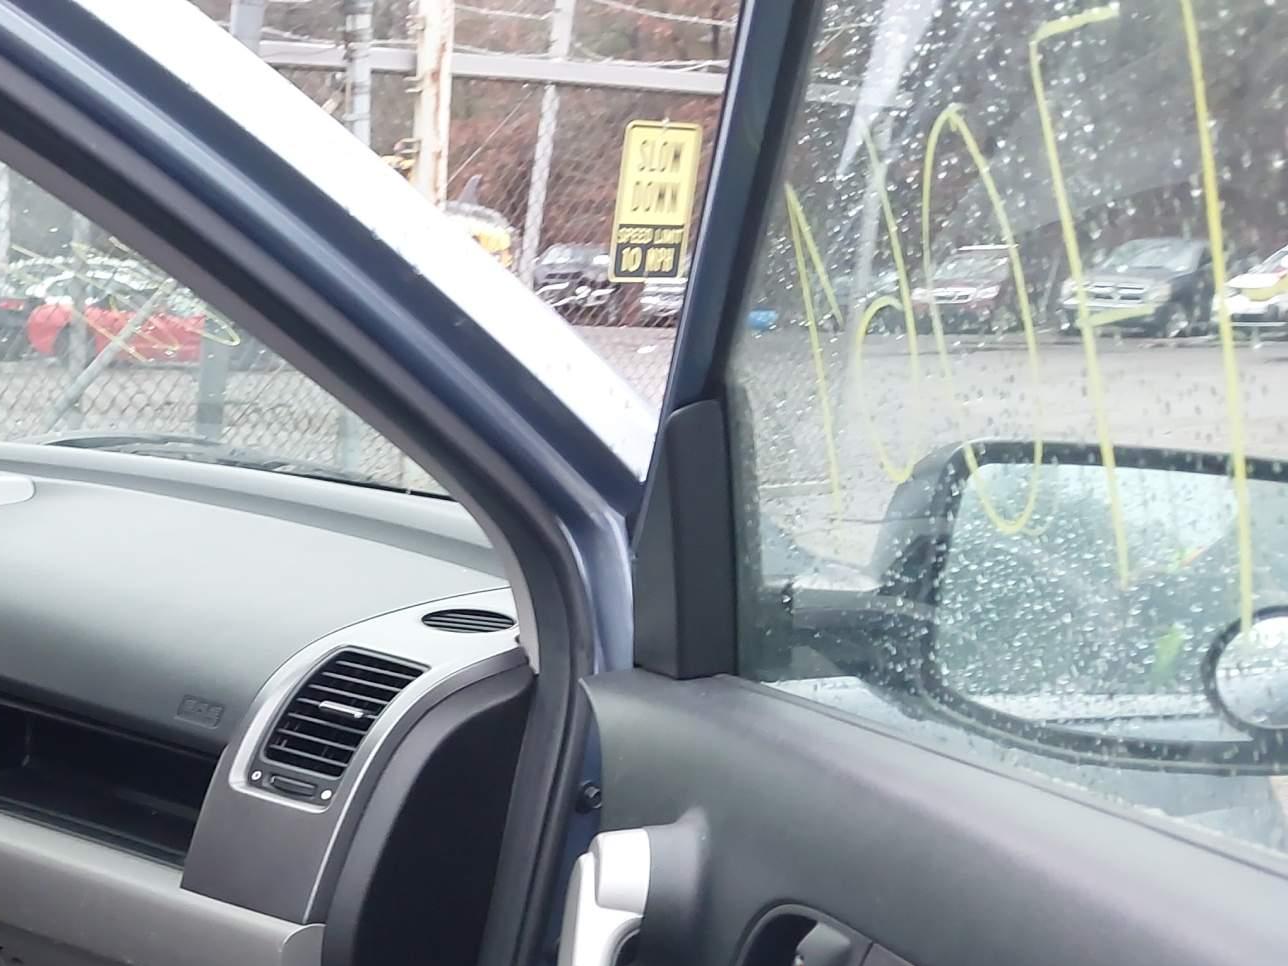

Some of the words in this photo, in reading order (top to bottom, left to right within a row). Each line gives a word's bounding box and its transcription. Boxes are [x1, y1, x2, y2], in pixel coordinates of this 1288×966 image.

[639, 140, 685, 173] SLOW
[632, 181, 681, 213] DOWN
[617, 227, 654, 244] SPEED
[654, 229, 685, 244] LIMIT
[621, 247, 643, 273] 10
[645, 247, 676, 273] MPH
